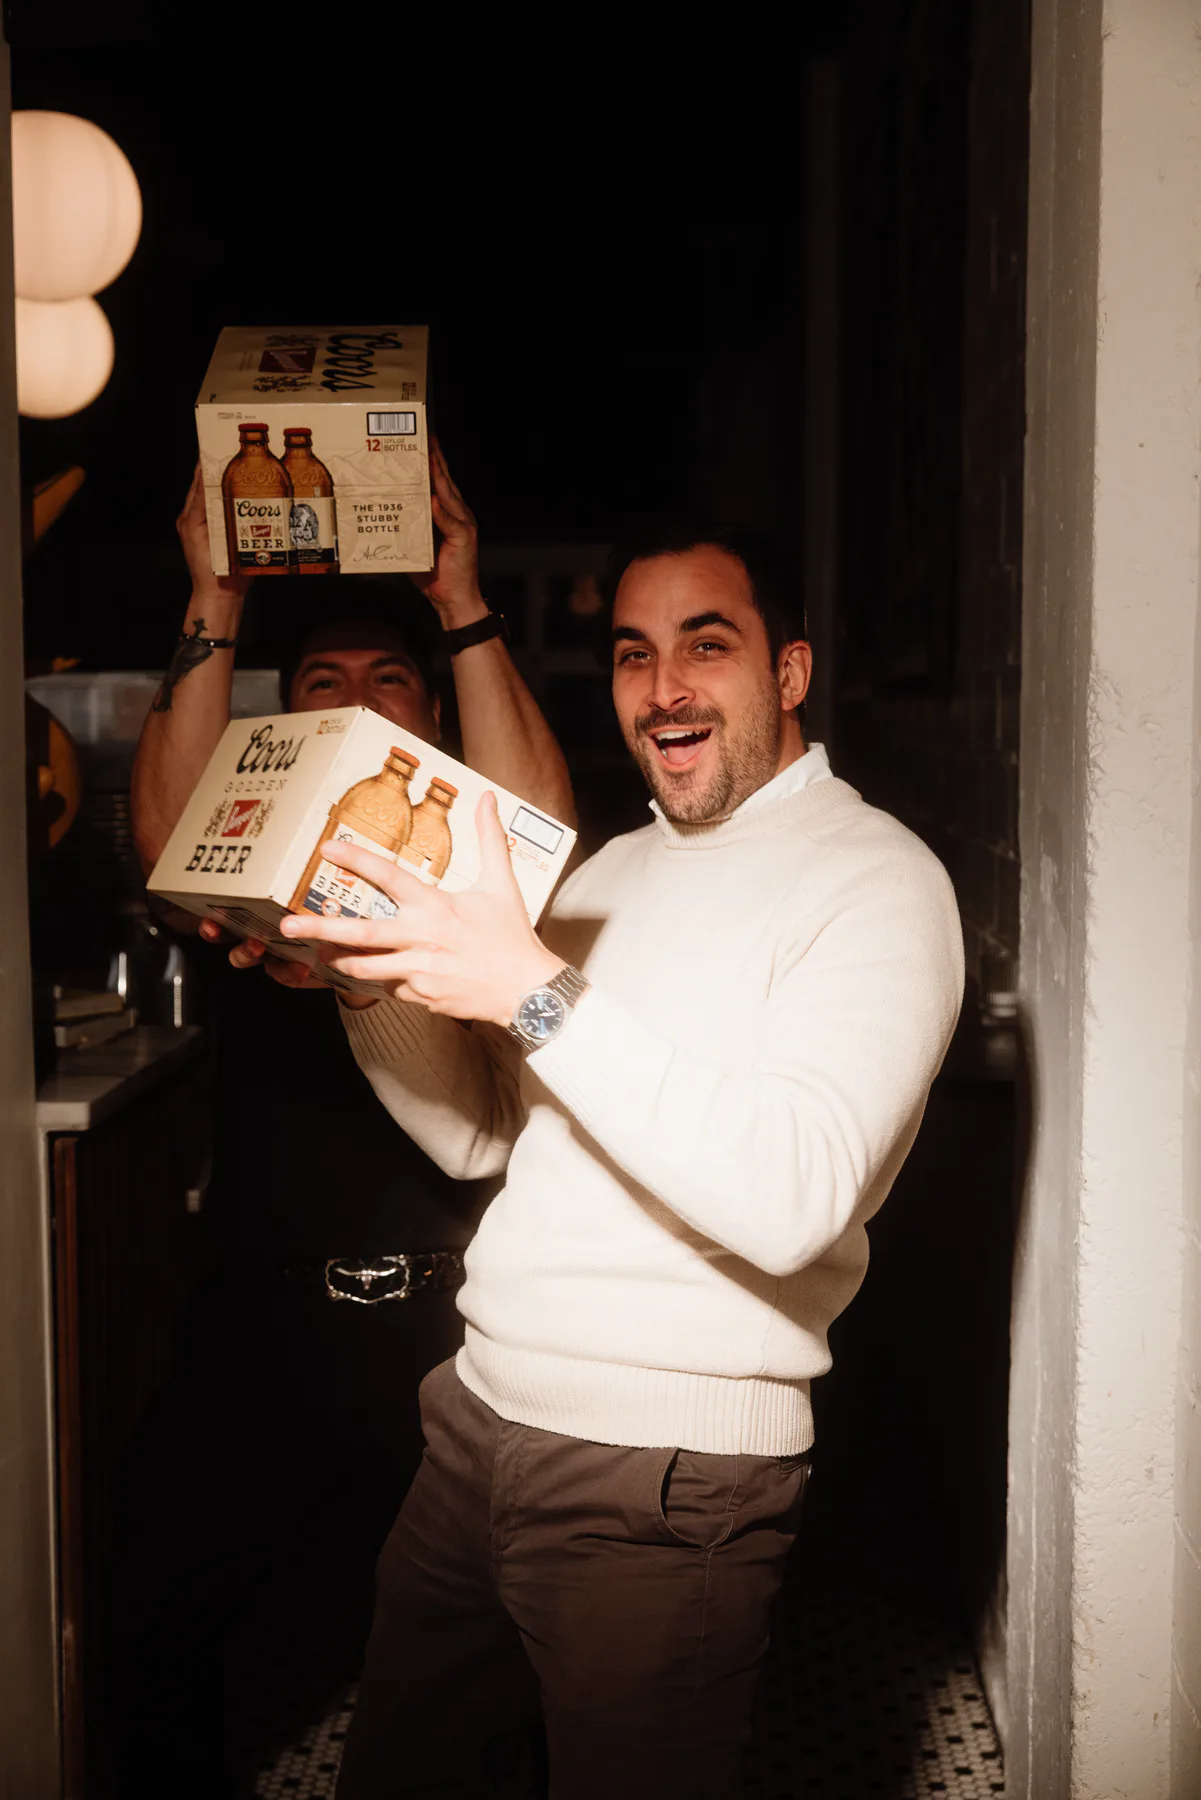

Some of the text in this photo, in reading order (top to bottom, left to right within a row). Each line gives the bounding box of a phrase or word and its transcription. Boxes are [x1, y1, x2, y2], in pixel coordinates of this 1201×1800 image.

[320, 331, 403, 393] Coors
[365, 438, 381, 452] 12
[383, 444, 418, 452] BOTTLES
[236, 500, 282, 518] Coors
[352, 503, 403, 512] THE 1936
[356, 514, 400, 523] STUBBY
[357, 524, 401, 534] BOTTLE
[240, 539, 285, 549] BEER
[236, 724, 308, 775] Coors
[224, 778, 289, 794] GOLDEN
[184, 844, 253, 875] BEER
[315, 874, 362, 910] BEER
